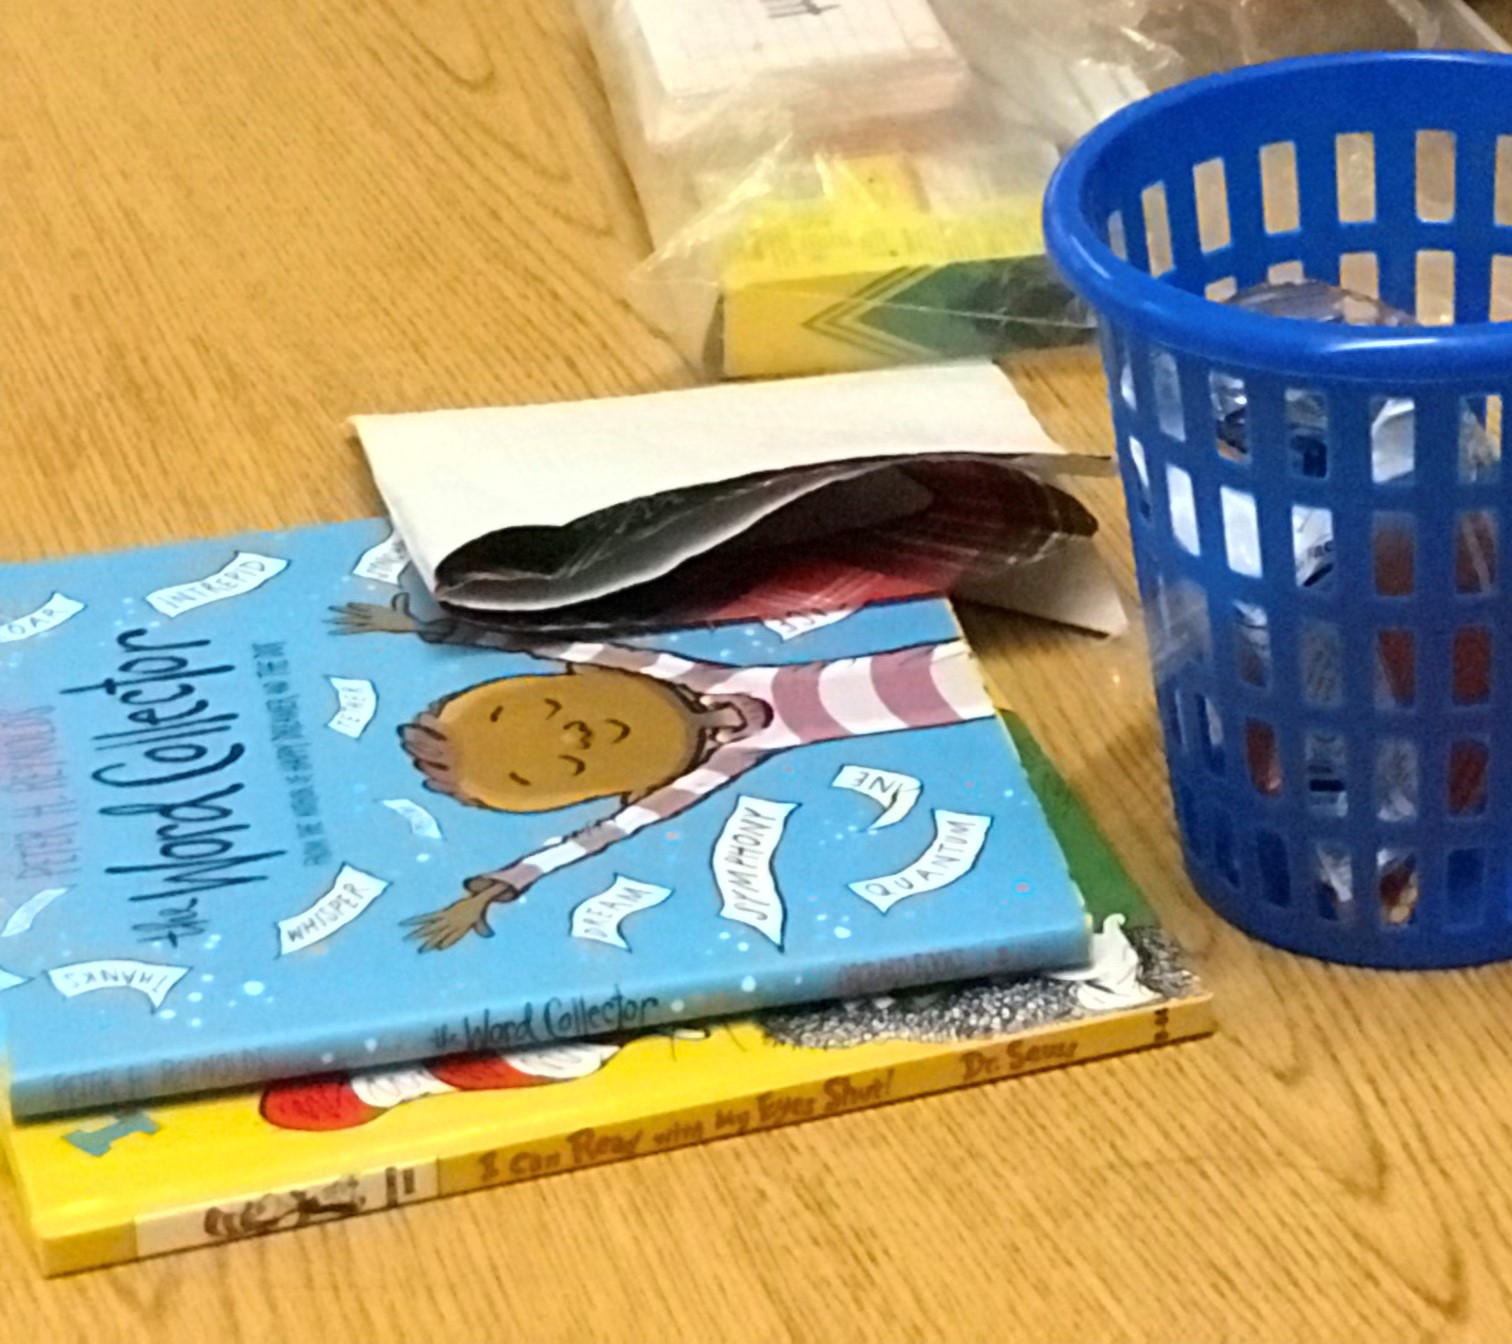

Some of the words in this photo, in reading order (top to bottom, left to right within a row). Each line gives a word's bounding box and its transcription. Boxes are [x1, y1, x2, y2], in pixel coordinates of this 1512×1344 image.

[159, 559, 268, 610] INTREPID
[59, 628, 246, 787] Collector
[99, 782, 287, 902] Word
[723, 806, 778, 923] SYMPHONY
[863, 818, 978, 900] QUANTUM
[131, 896, 210, 948] the
[287, 882, 367, 942] WHISPER
[581, 885, 651, 941] DREAM
[64, 966, 166, 993] THANKS
[462, 1001, 542, 1048] Word
[543, 984, 659, 1037] Collector
[823, 1068, 895, 1110] Shut!
[961, 1050, 1001, 1082] Dr.
[1006, 1039, 1079, 1070] Seuss
